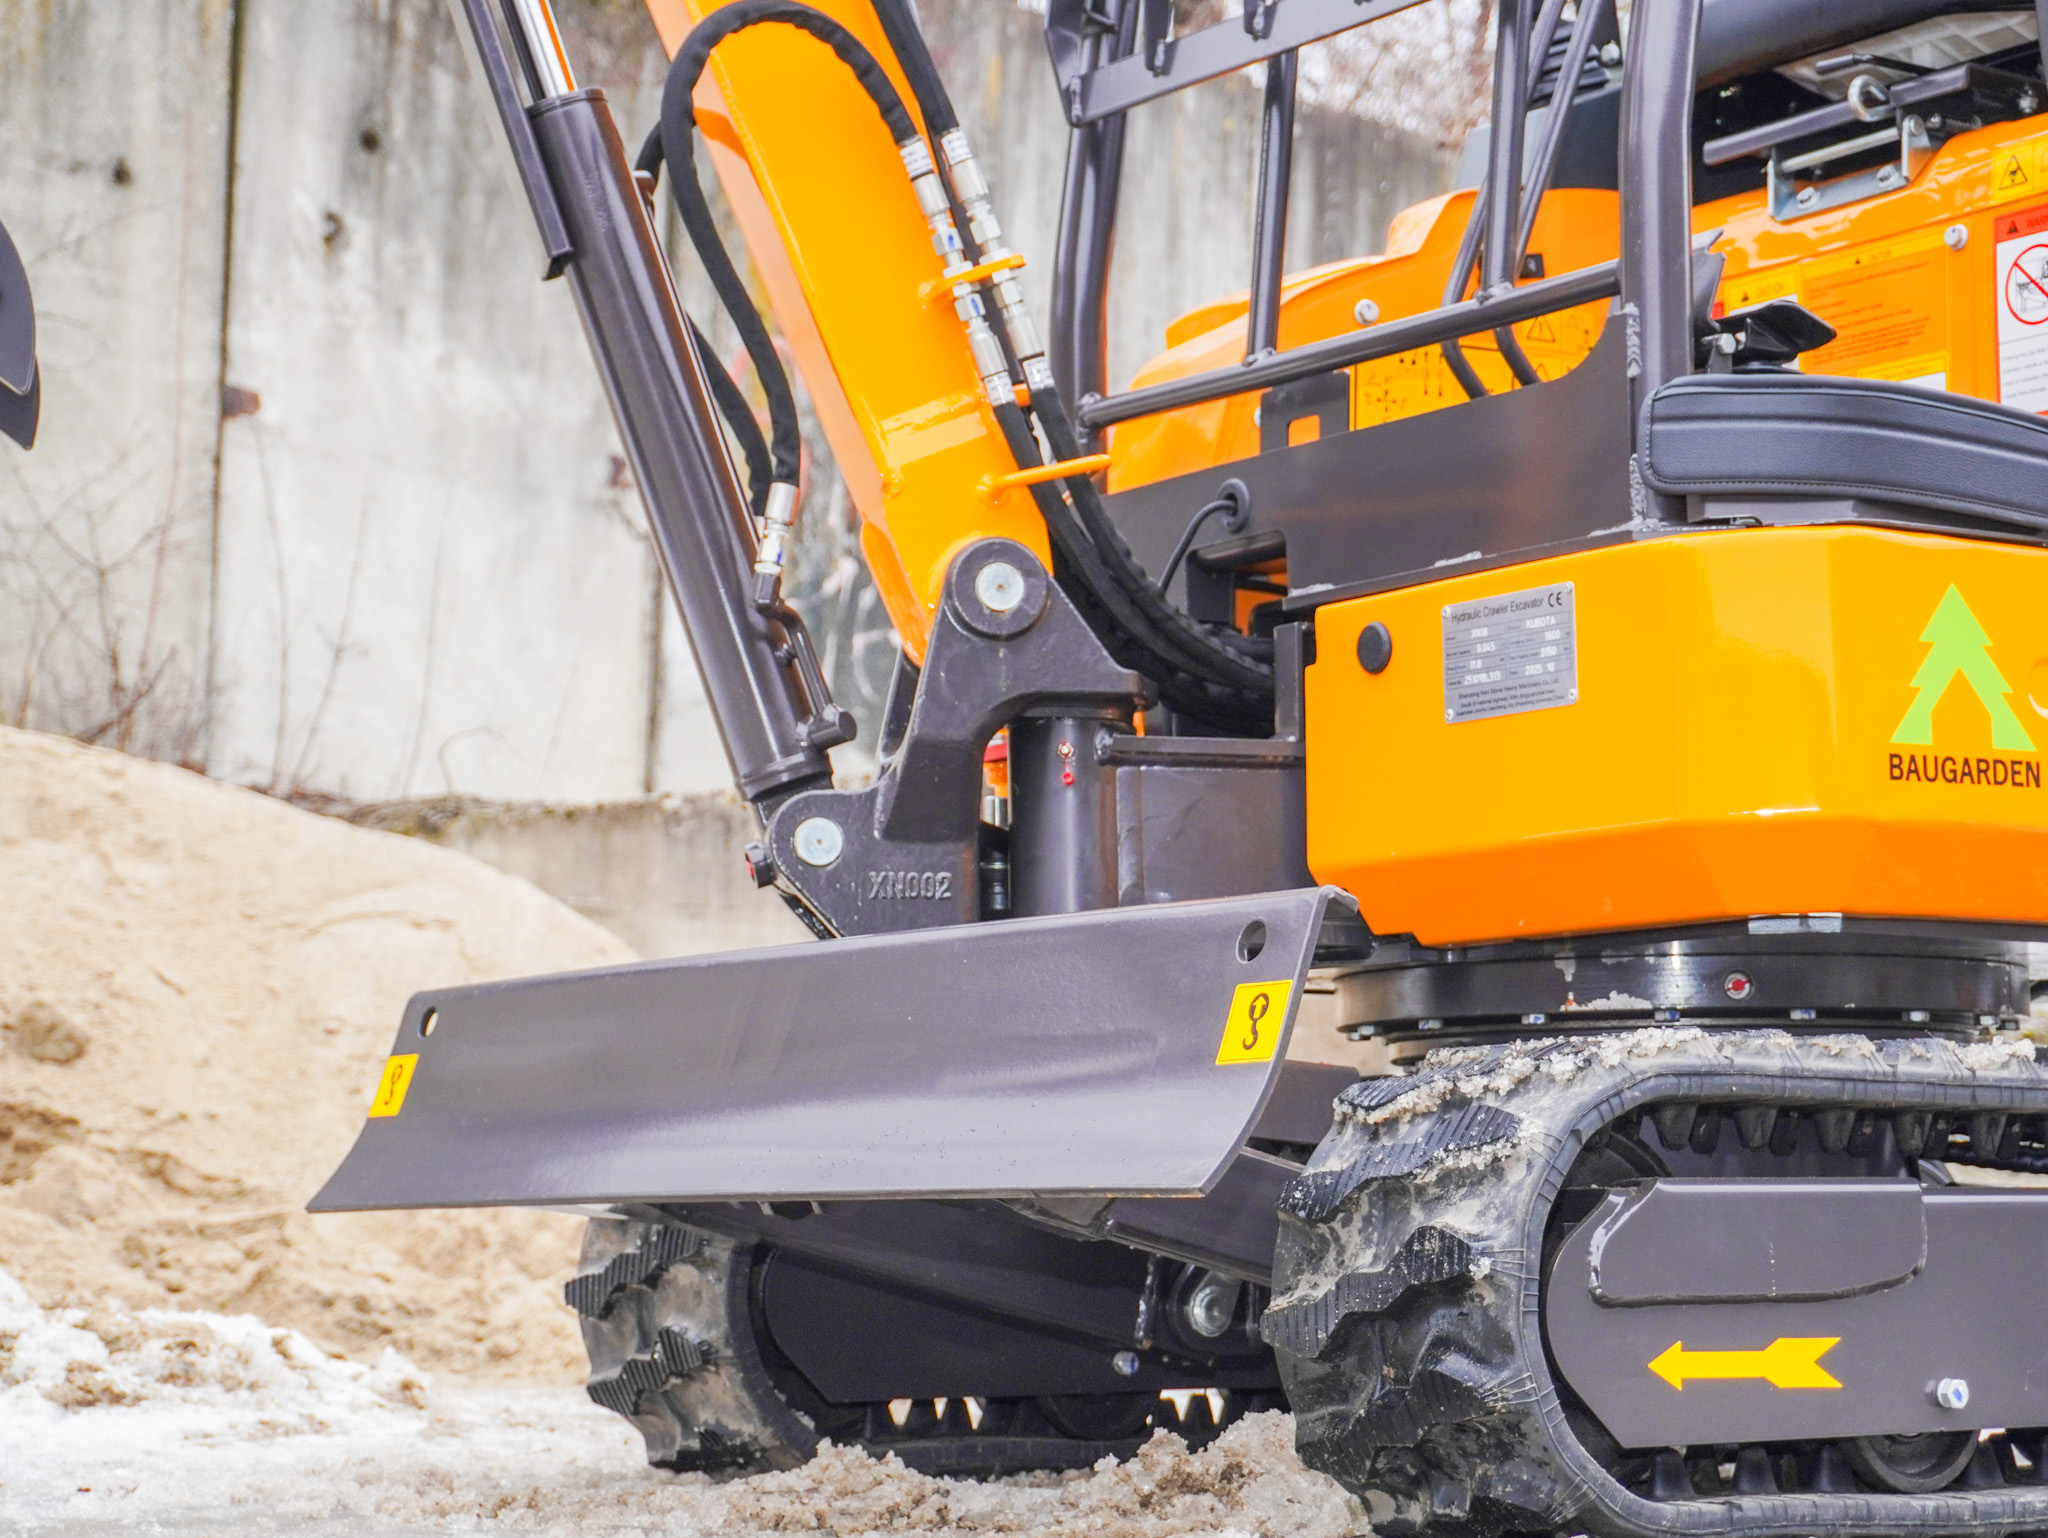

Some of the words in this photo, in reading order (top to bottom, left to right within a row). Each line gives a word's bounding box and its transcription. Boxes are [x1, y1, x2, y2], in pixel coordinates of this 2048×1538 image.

[2026, 213, 2048, 229] WAR
[1548, 591, 1562, 607] CE
[1452, 608, 1481, 625] Hydraulic
[1483, 602, 1508, 617] Crawler
[1510, 596, 1543, 612] Excavator
[1526, 615, 1556, 629] KUBOTA
[1525, 664, 1542, 675] 2025
[1889, 753, 2041, 789] BAUGARDEN
[869, 871, 952, 900] XN002
